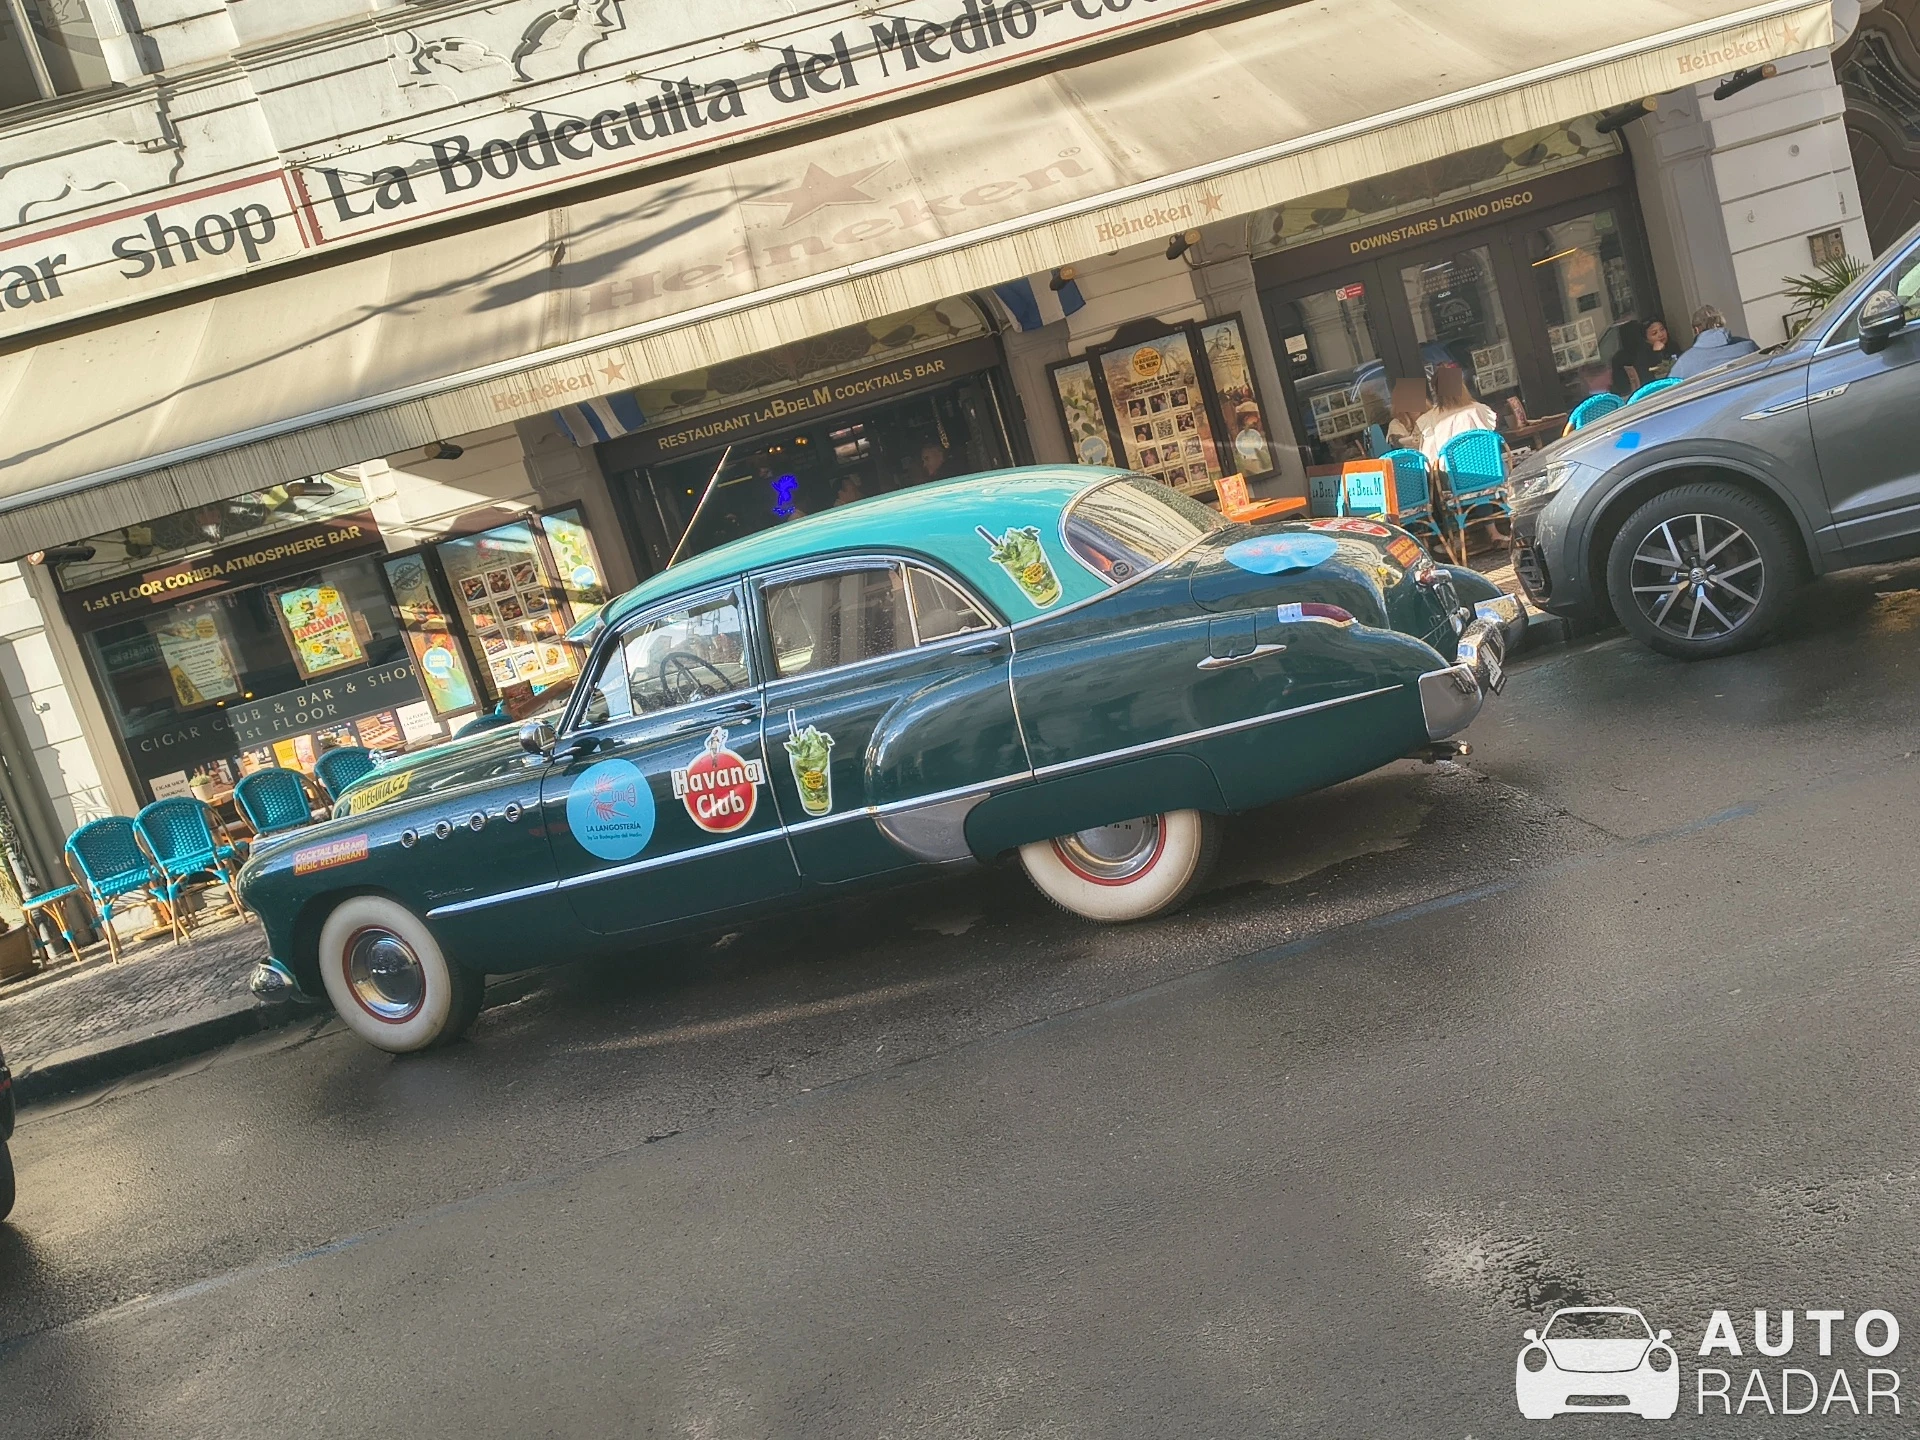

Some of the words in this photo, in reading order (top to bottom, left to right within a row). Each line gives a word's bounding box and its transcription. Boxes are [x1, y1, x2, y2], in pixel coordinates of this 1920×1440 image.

[1676, 36, 1772, 75] Heineken
[323, 164, 418, 223] La
[767, 31, 860, 105] del
[581, 157, 1094, 317] Heineken
[1095, 202, 1193, 243] Heineken
[1350, 219, 1438, 254] DOWNSTAIRS
[1440, 204, 1489, 228] LATINO
[1490, 191, 1533, 213] DISCO
[0, 253, 67, 313] ar
[112, 203, 276, 280] shop
[490, 371, 595, 413] Heineken
[658, 413, 750, 450] RESTAURANT
[834, 368, 913, 401] COCKTAILS
[914, 359, 946, 378] BAR
[110, 579, 165, 610] FLOOR
[165, 563, 223, 590] COHIBA
[225, 535, 326, 573] ATMOSPHERE
[327, 525, 362, 545] BAR
[292, 610, 348, 640] TAKEAWAY
[140, 726, 201, 752] CIGAR
[213, 708, 261, 732] CLUB
[274, 702, 286, 714] &
[297, 688, 334, 708] BAR
[345, 682, 357, 695] &
[233, 726, 263, 744] 1st
[272, 703, 338, 731] FLOOR
[673, 762, 760, 796] Havana
[696, 790, 745, 819] Club
[332, 841, 352, 853] BAR
[586, 825, 594, 833] LA
[595, 820, 642, 832] LANGOSTERÍA
[295, 861, 318, 874] MUSIC
[320, 848, 366, 866] RESTAURANT
